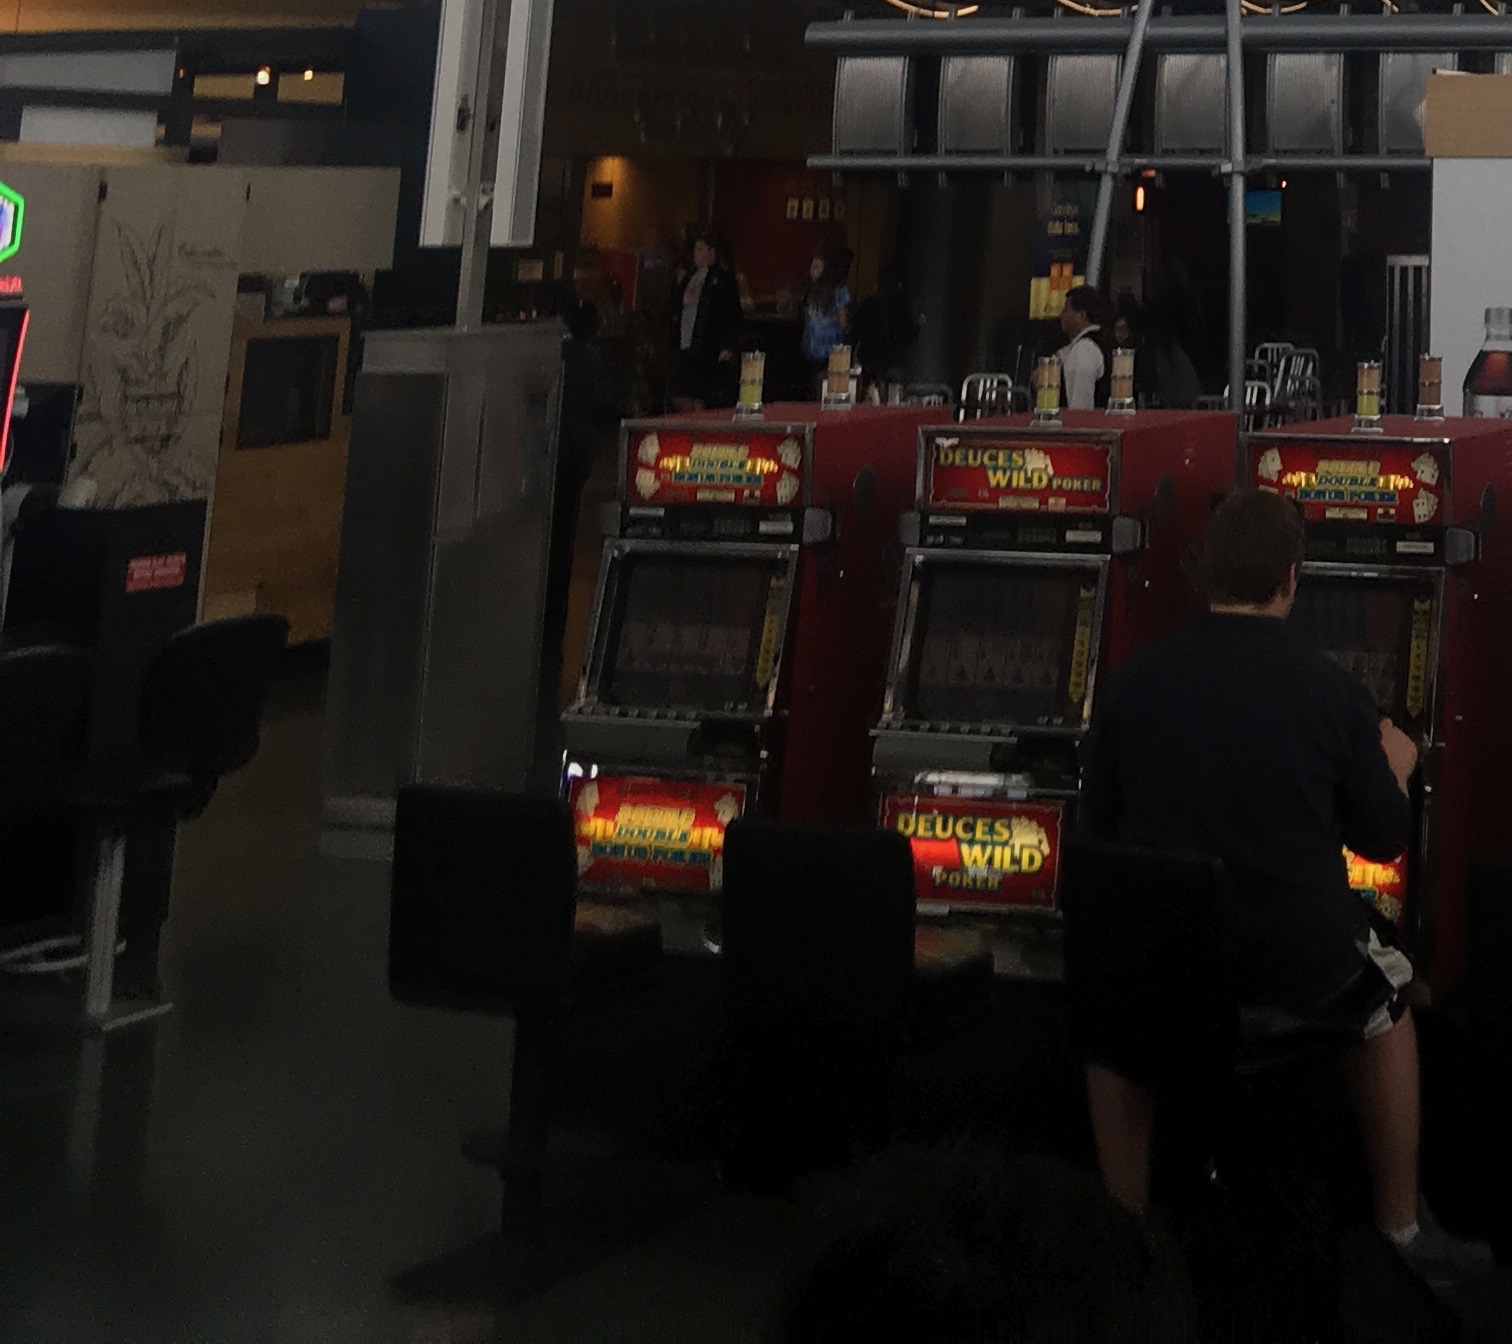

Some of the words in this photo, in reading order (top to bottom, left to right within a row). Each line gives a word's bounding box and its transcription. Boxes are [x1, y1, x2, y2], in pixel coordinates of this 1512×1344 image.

[939, 448, 1024, 468] DEUCES
[986, 468, 1049, 490] WILD
[1051, 476, 1102, 492] POKER
[897, 814, 1011, 843] DEUCES
[960, 842, 1044, 873] WILD
